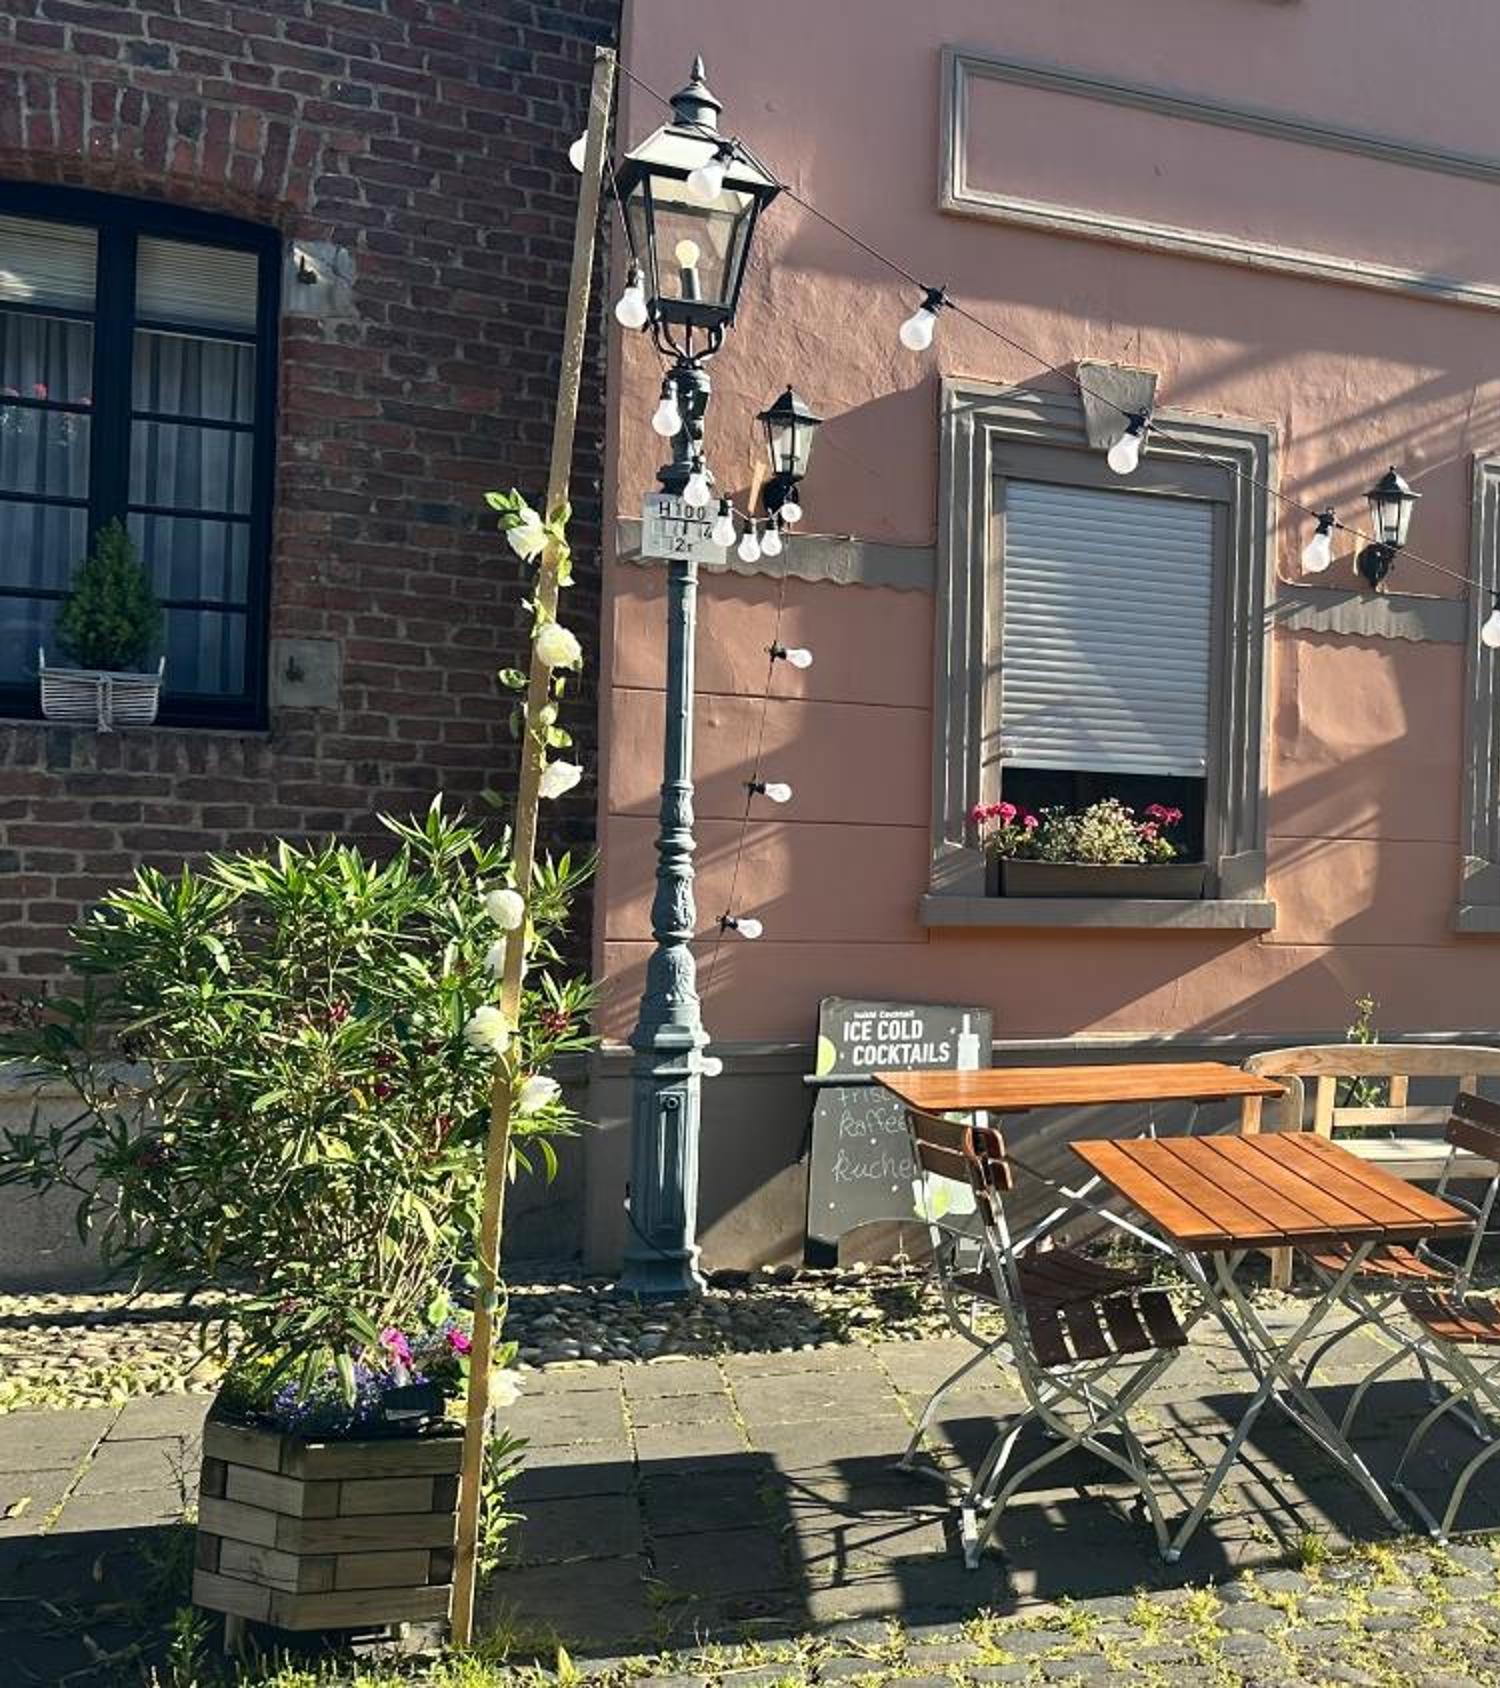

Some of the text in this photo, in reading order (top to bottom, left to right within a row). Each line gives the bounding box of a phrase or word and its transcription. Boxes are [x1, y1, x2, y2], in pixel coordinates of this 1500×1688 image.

[843, 1019, 924, 1042] ICE COLD
[852, 1041, 951, 1066] COCKTAILS
